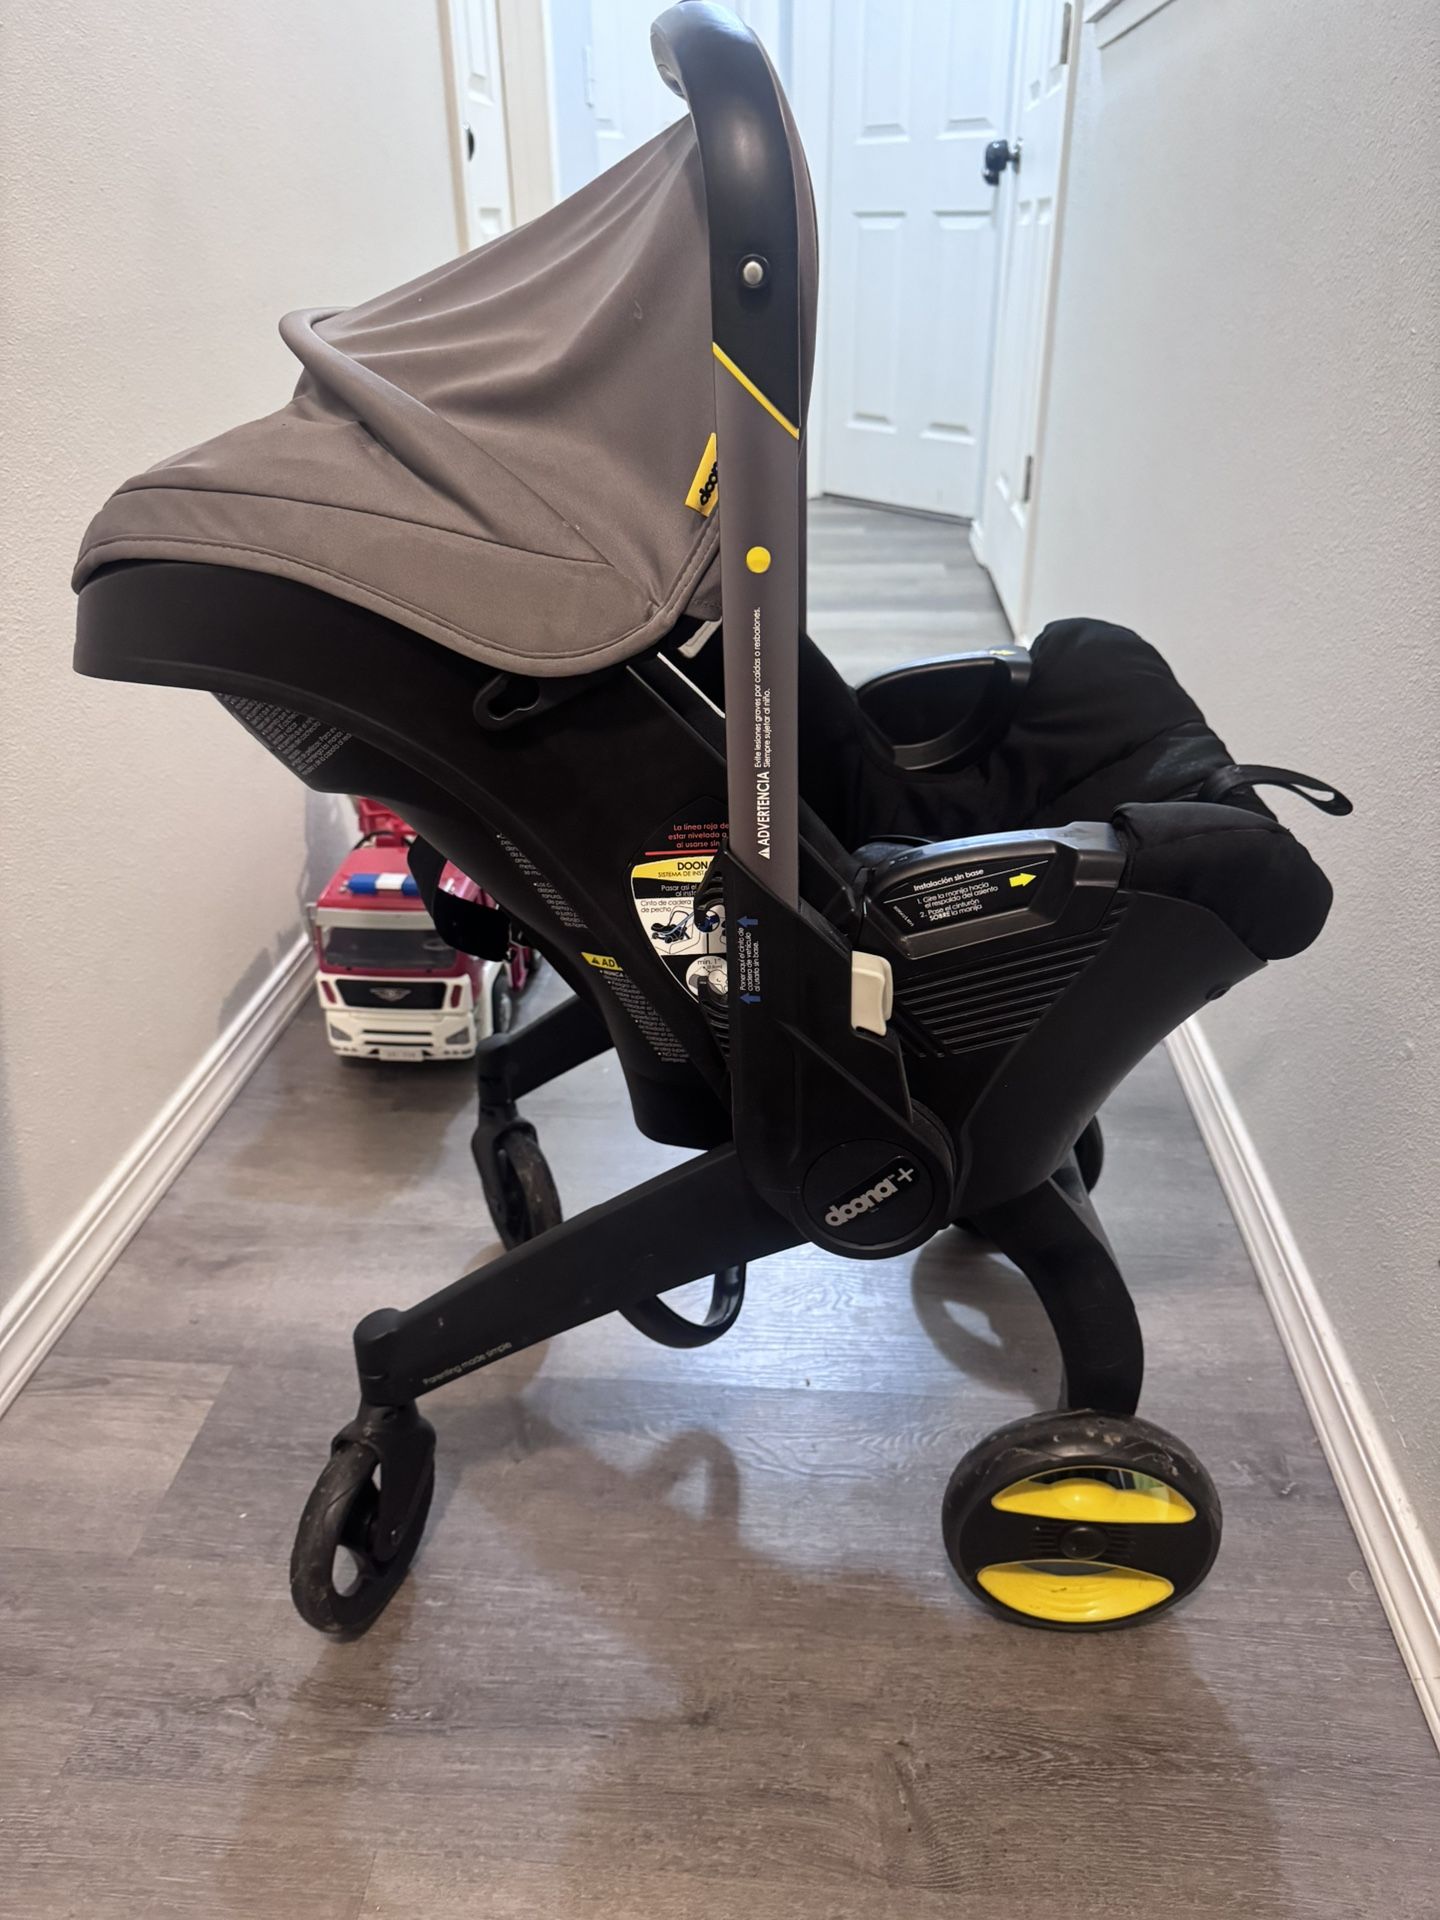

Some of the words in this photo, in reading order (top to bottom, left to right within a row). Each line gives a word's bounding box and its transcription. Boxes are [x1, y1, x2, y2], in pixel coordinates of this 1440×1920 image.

[752, 607, 761, 650] resbalones.
[754, 685, 762, 697] por
[762, 688, 771, 706] niño.
[754, 698, 763, 722] graves
[763, 707, 771, 715] al
[763, 716, 772, 739] sujetar
[754, 723, 762, 750] lesiones
[754, 751, 762, 768] Evite
[763, 740, 772, 768] Siempre
[757, 772, 770, 845] ADVERTENCIA
[703, 823, 718, 831] roja
[677, 861, 708, 870] DOON
[914, 876, 953, 892] Instalación
[954, 873, 964, 882] sin
[965, 869, 984, 879] base
[922, 895, 937, 904] Gire
[945, 886, 969, 899] manija
[969, 882, 990, 892] hacia
[931, 896, 961, 908] respaldo
[961, 891, 973, 899] del
[973, 886, 999, 896] asiento
[928, 906, 944, 916] Pase
[952, 899, 980, 910] cinturón
[930, 912, 951, 921] SOBRE
[959, 904, 983, 914] manija
[737, 927, 744, 936] de
[601, 958, 616, 967] AD
[746, 959, 752, 968] de
